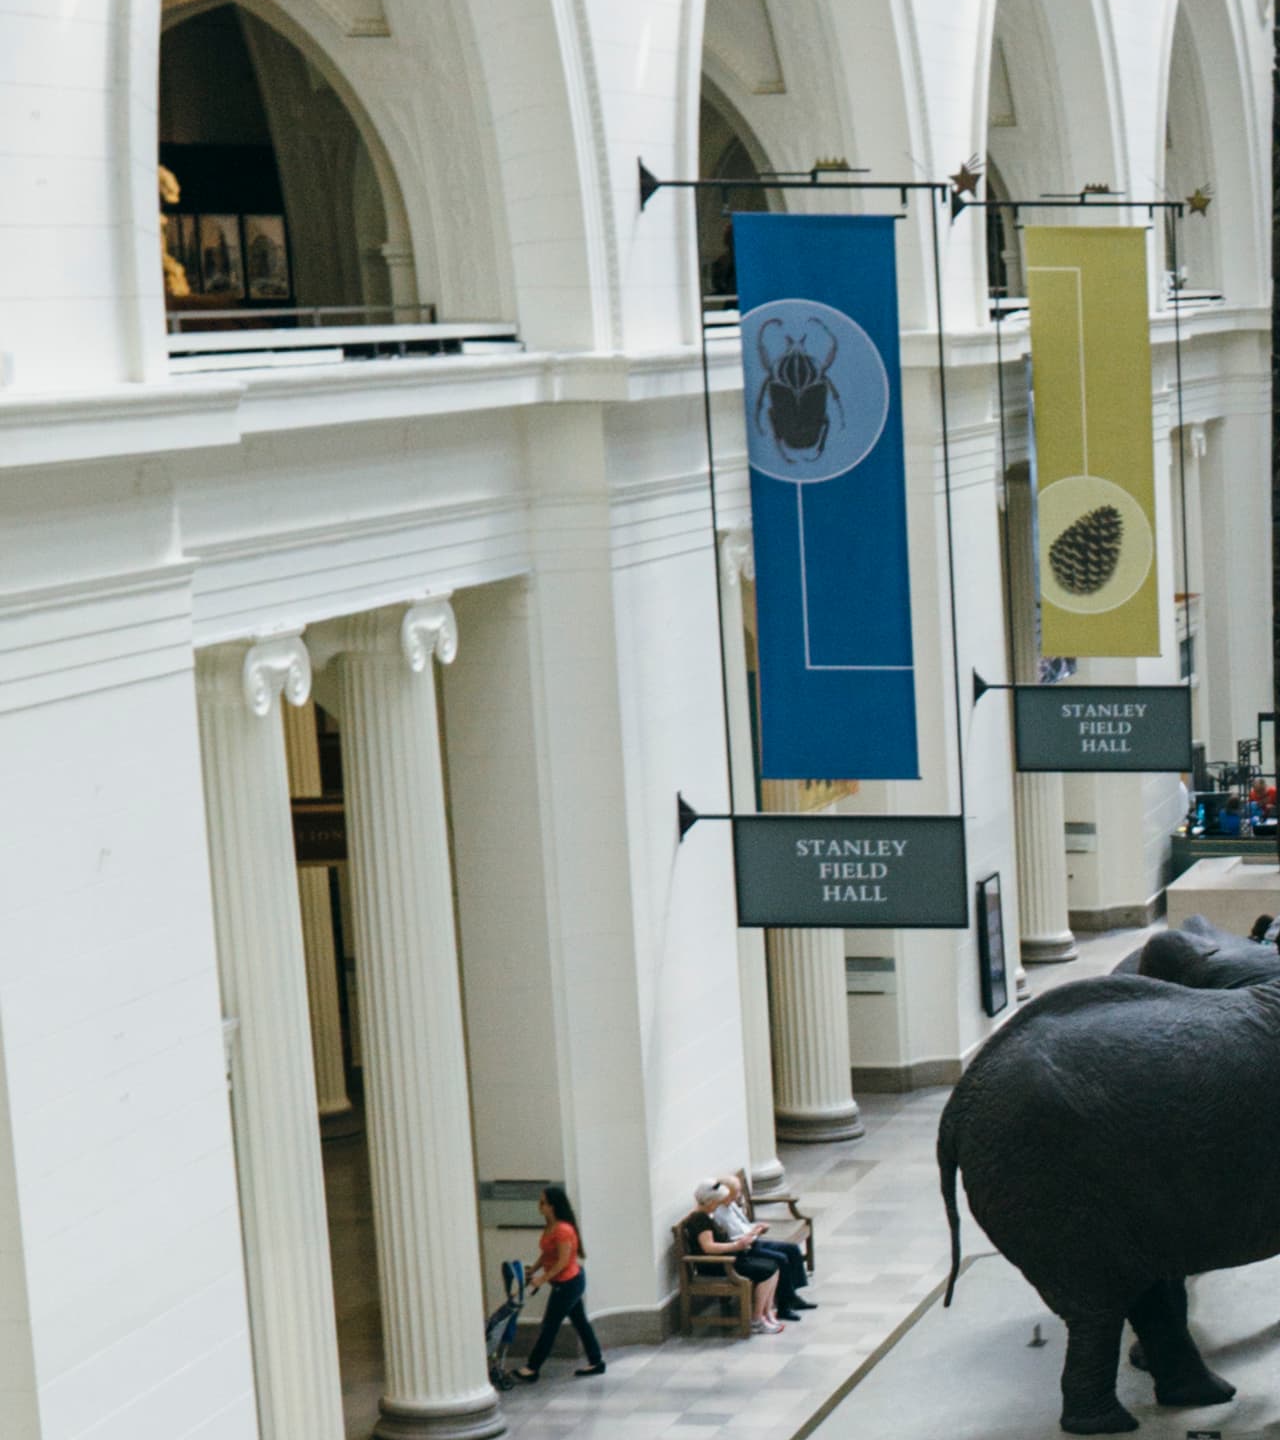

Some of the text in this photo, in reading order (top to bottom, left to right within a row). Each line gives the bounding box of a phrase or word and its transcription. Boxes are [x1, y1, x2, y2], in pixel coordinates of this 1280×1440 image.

[1061, 703, 1147, 718] STANLEY
[1079, 721, 1132, 735] FIELD
[1081, 738, 1131, 753] HALL
[796, 839, 908, 857] STANLEY
[819, 862, 888, 880] FIELD
[822, 885, 888, 902] HALL
